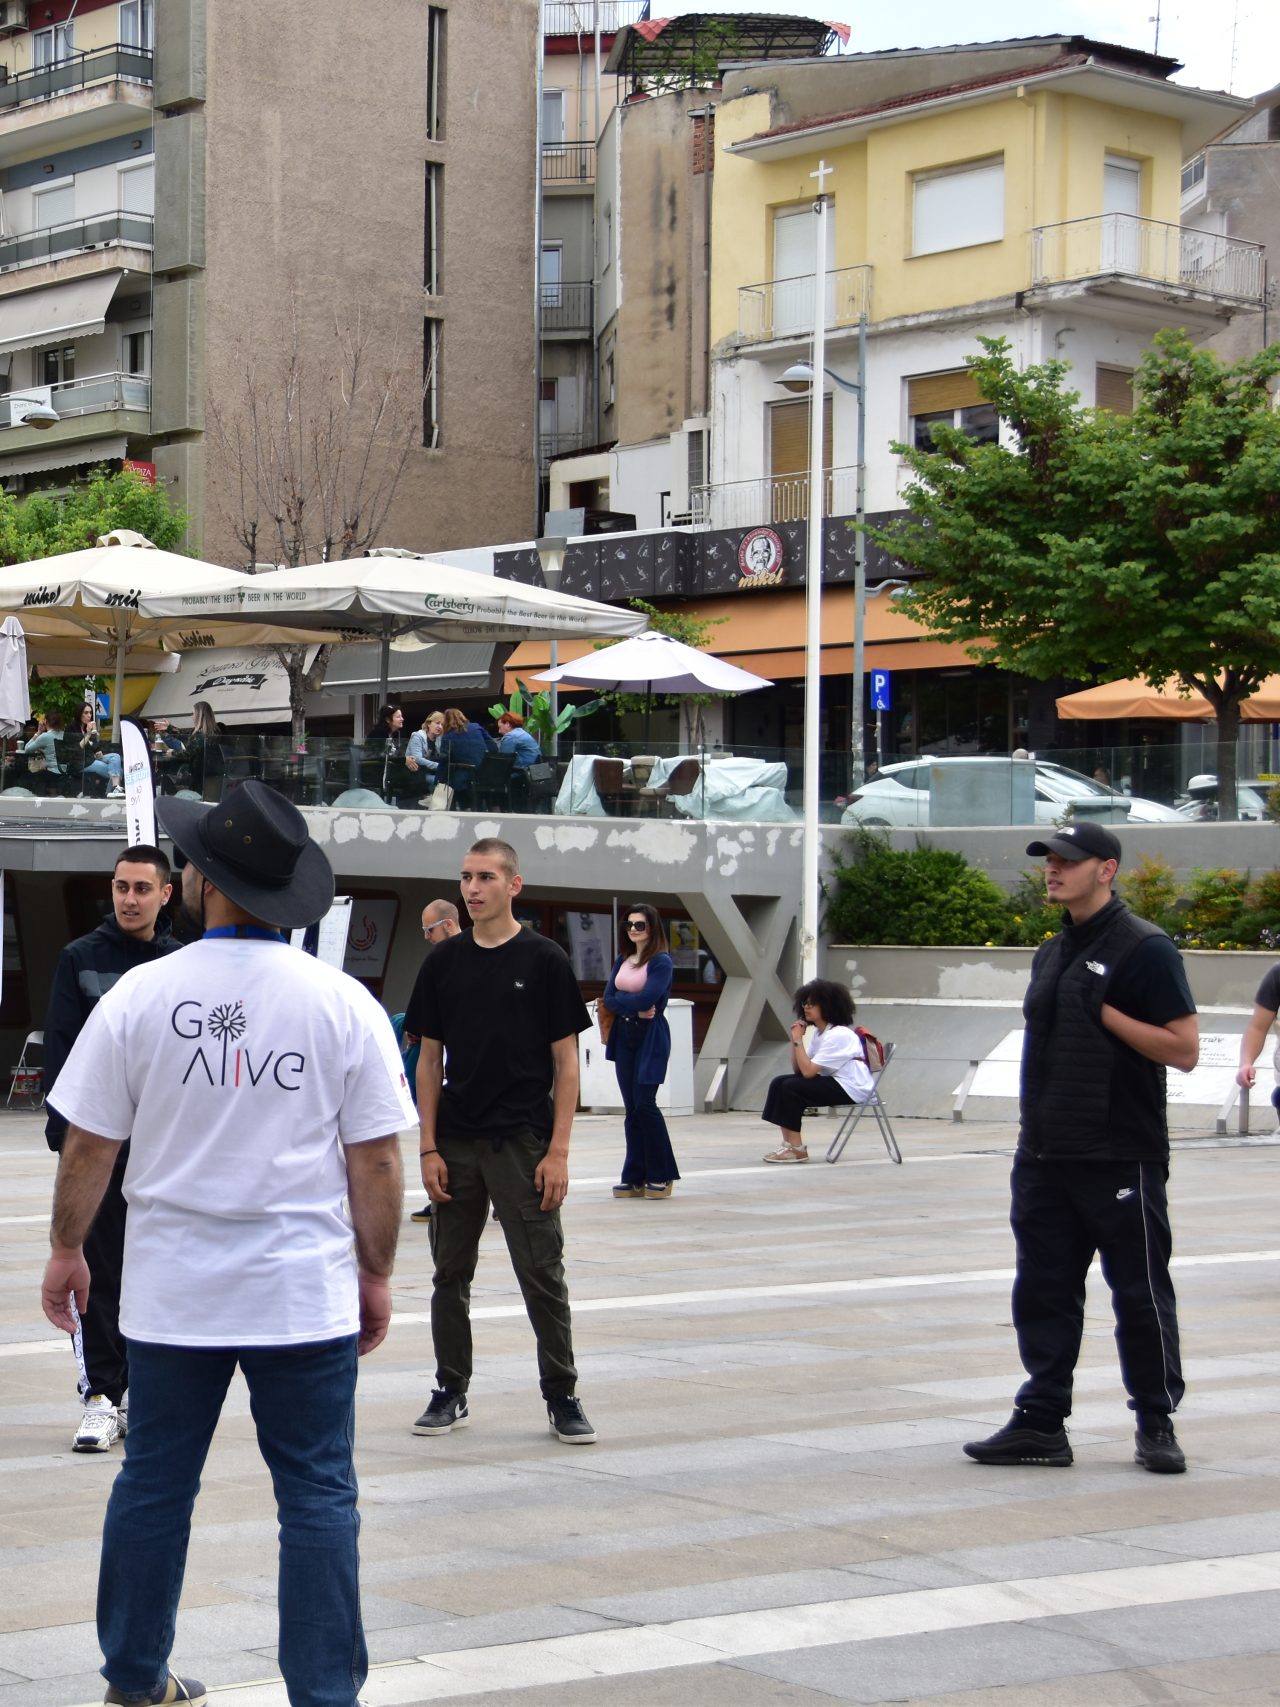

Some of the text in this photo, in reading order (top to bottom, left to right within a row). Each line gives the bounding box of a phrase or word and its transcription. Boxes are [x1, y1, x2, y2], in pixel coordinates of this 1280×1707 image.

[738, 567, 784, 588] mikel
[23, 585, 61, 606] mikel
[182, 596, 208, 605] PROBABLY
[223, 594, 236, 603] BEST
[247, 593, 261, 602] BEER
[263, 593, 270, 601] IN
[273, 592, 283, 601] THE
[286, 592, 306, 601] WORLD
[424, 594, 475, 613] Carlsberg
[476, 605, 587, 623] Probably the Best Beer in the World
[875, 674, 886, 693] P
